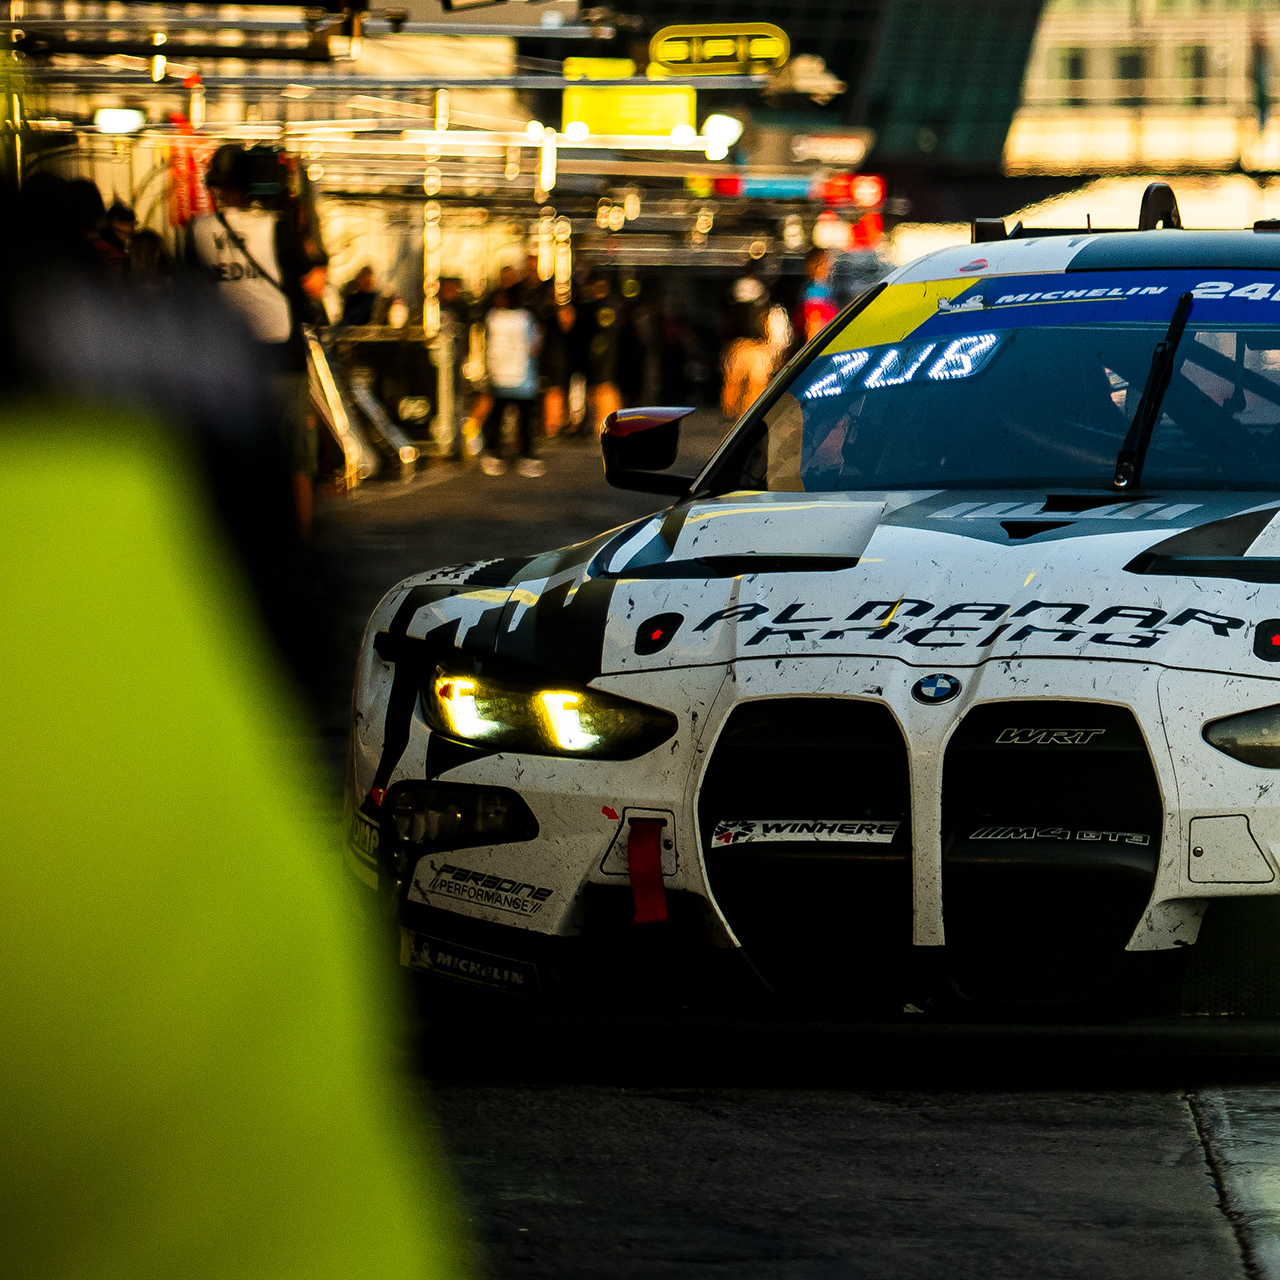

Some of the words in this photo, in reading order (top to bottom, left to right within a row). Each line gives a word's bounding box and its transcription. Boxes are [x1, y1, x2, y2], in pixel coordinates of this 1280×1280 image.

[995, 286, 1169, 306] MICHELIN
[692, 598, 1247, 638] ALMANAR
[995, 727, 1107, 745] WRT
[761, 822, 901, 836] WINHERE
[1076, 830, 1151, 846] GT3
[436, 951, 525, 986] MICHELIN
